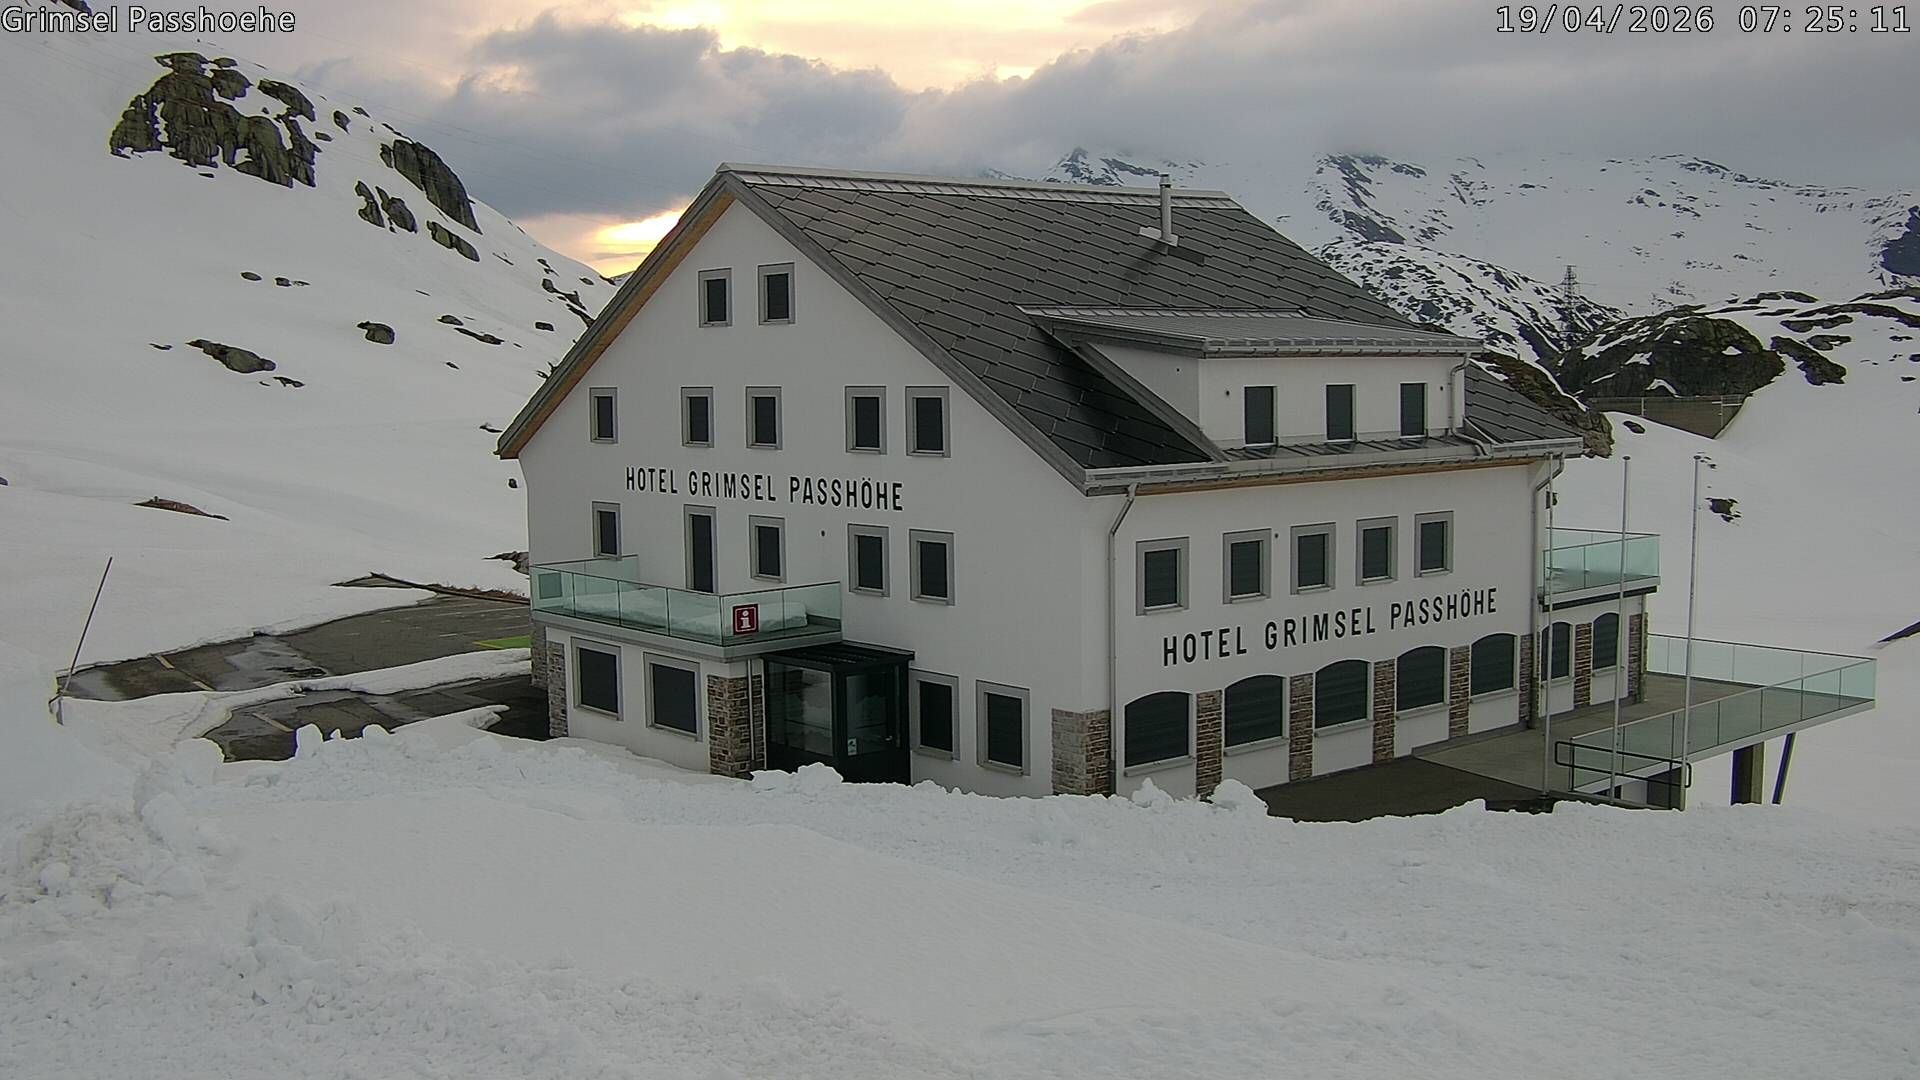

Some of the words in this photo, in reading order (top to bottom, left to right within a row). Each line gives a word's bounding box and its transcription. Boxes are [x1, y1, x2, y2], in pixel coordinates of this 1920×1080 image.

[626, 467, 678, 494] HOTEL
[688, 470, 777, 502] GRIMSEL
[790, 476, 904, 511] PASSHÖHE
[1164, 627, 1247, 667] HOTEL
[1265, 607, 1376, 650] GRIMSEL
[1391, 588, 1497, 631] PASSHÖHE
